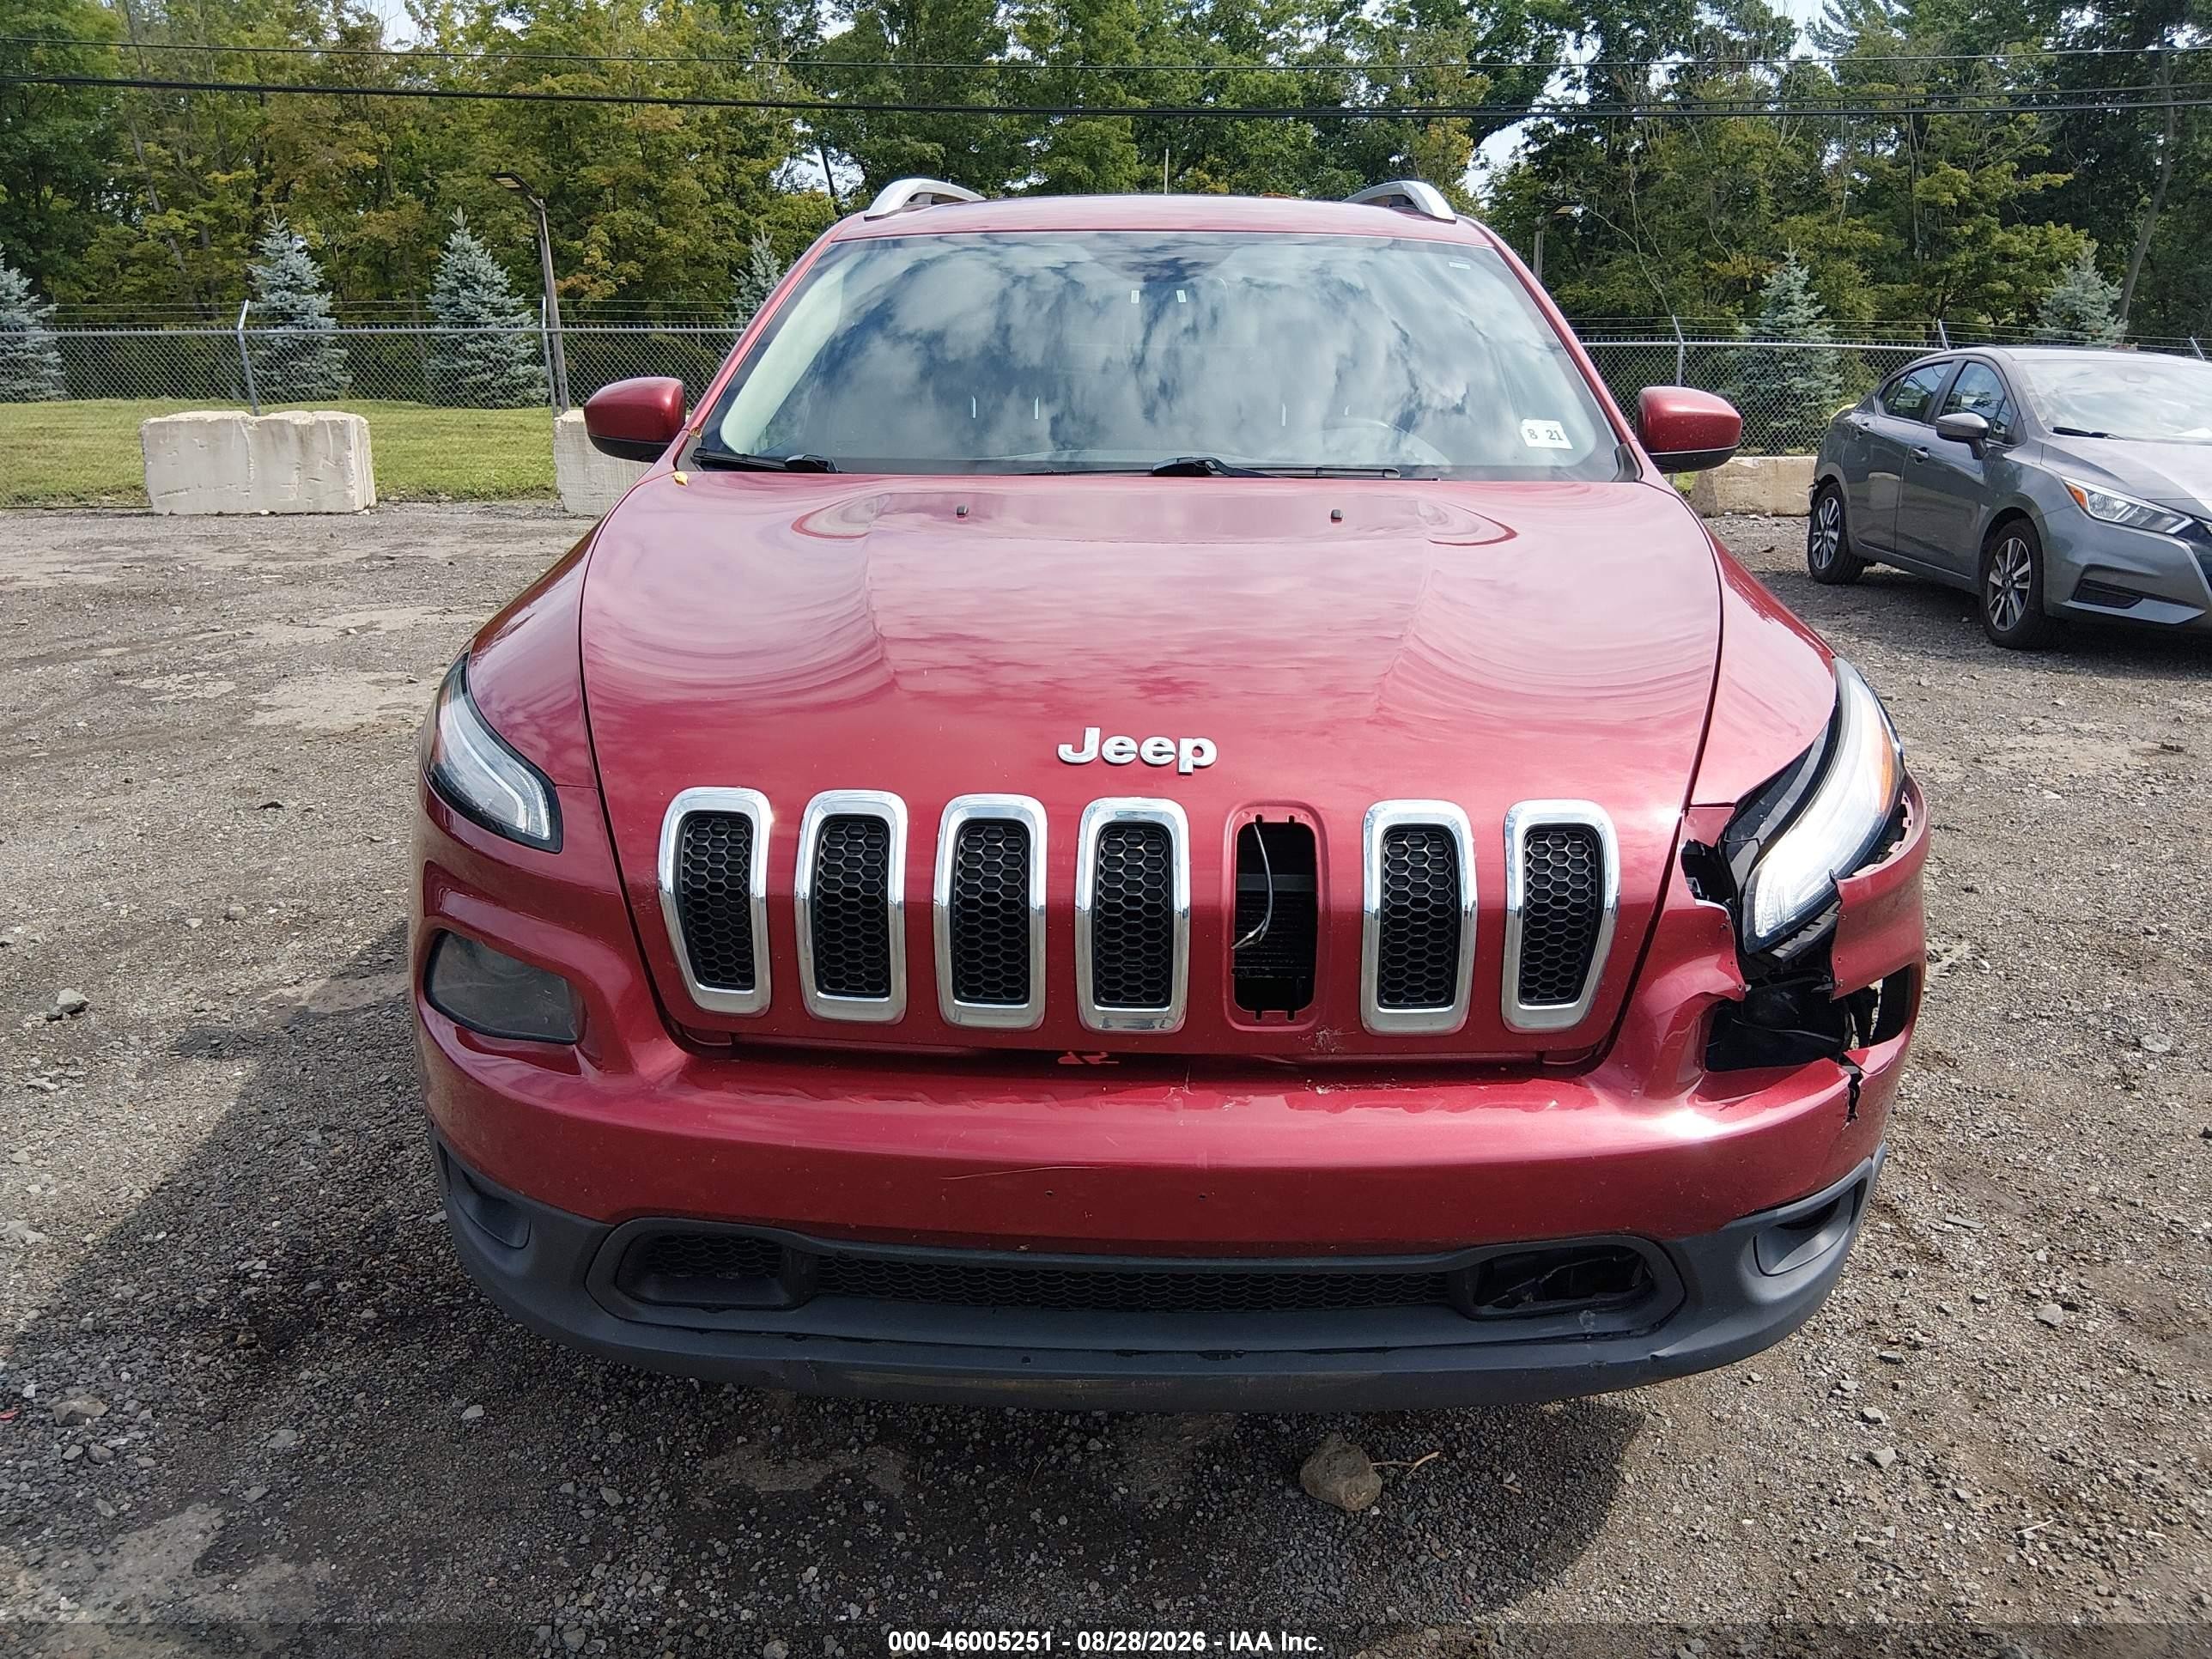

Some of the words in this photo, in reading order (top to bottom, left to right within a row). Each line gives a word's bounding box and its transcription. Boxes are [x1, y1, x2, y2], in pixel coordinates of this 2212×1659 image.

[1527, 428, 1539, 440] 8
[1546, 429, 1564, 441] 21
[1057, 726, 1218, 775] Jeep
